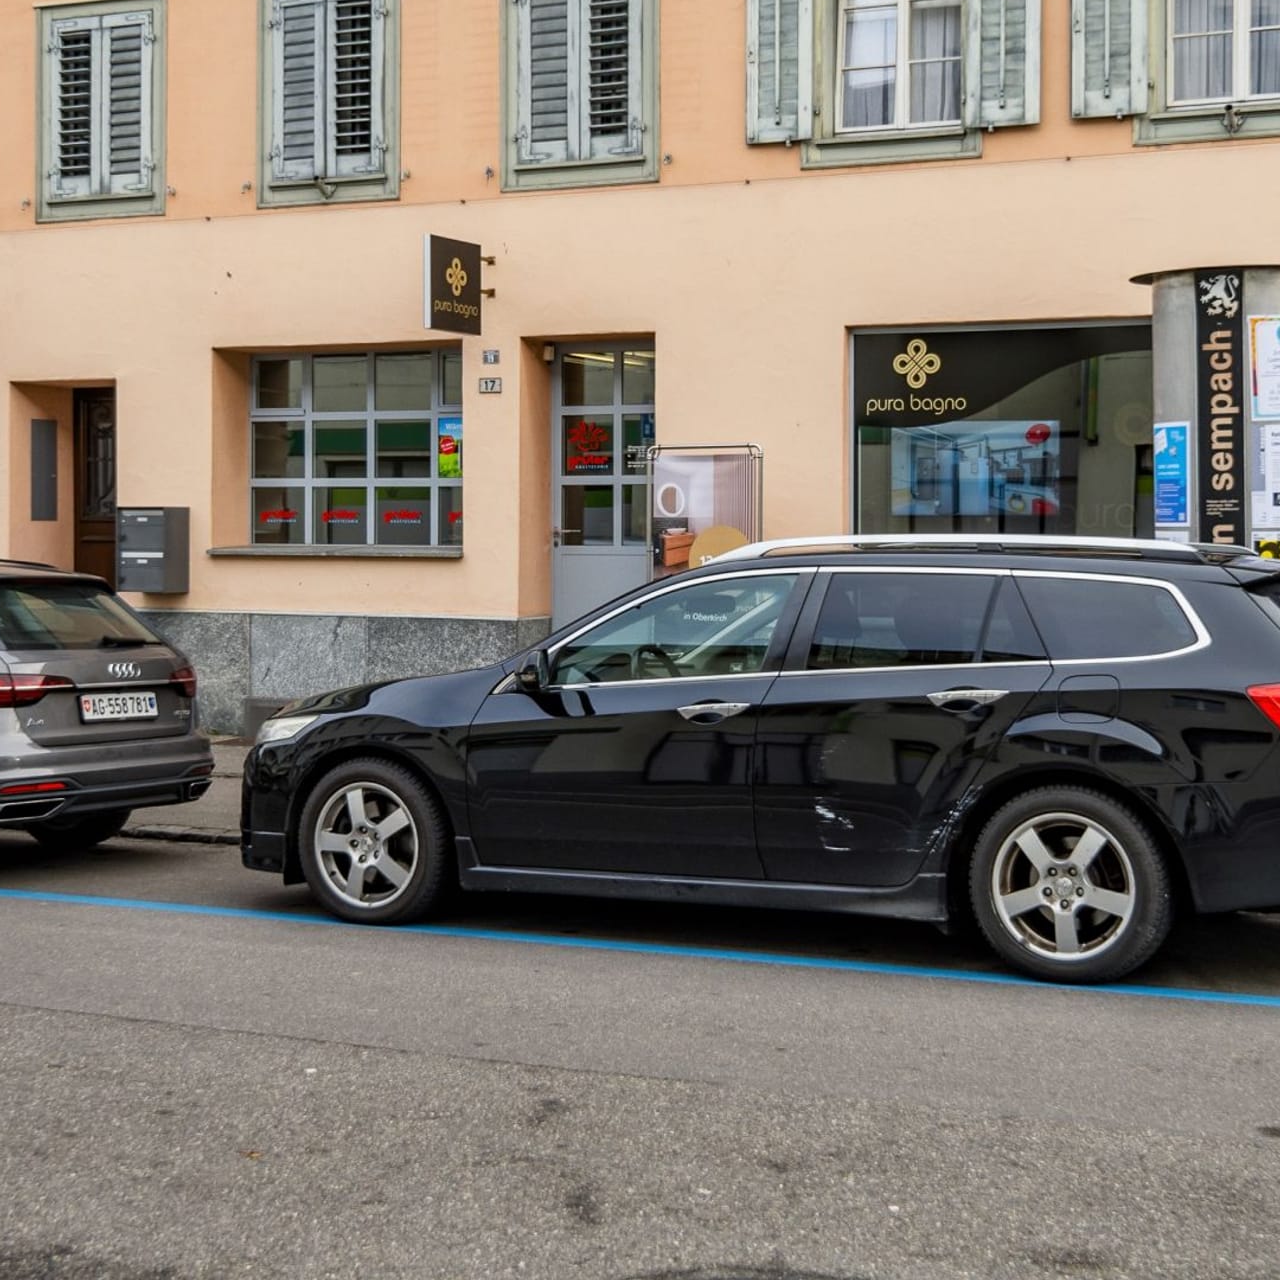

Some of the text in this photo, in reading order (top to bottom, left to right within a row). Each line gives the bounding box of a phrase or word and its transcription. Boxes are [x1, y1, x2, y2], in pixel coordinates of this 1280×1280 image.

[433, 299, 479, 318] pura bagno
[484, 380, 496, 391] 17
[866, 393, 967, 416] pura bagno
[1201, 329, 1240, 491] sempach
[692, 613, 728, 622] Oberkirch
